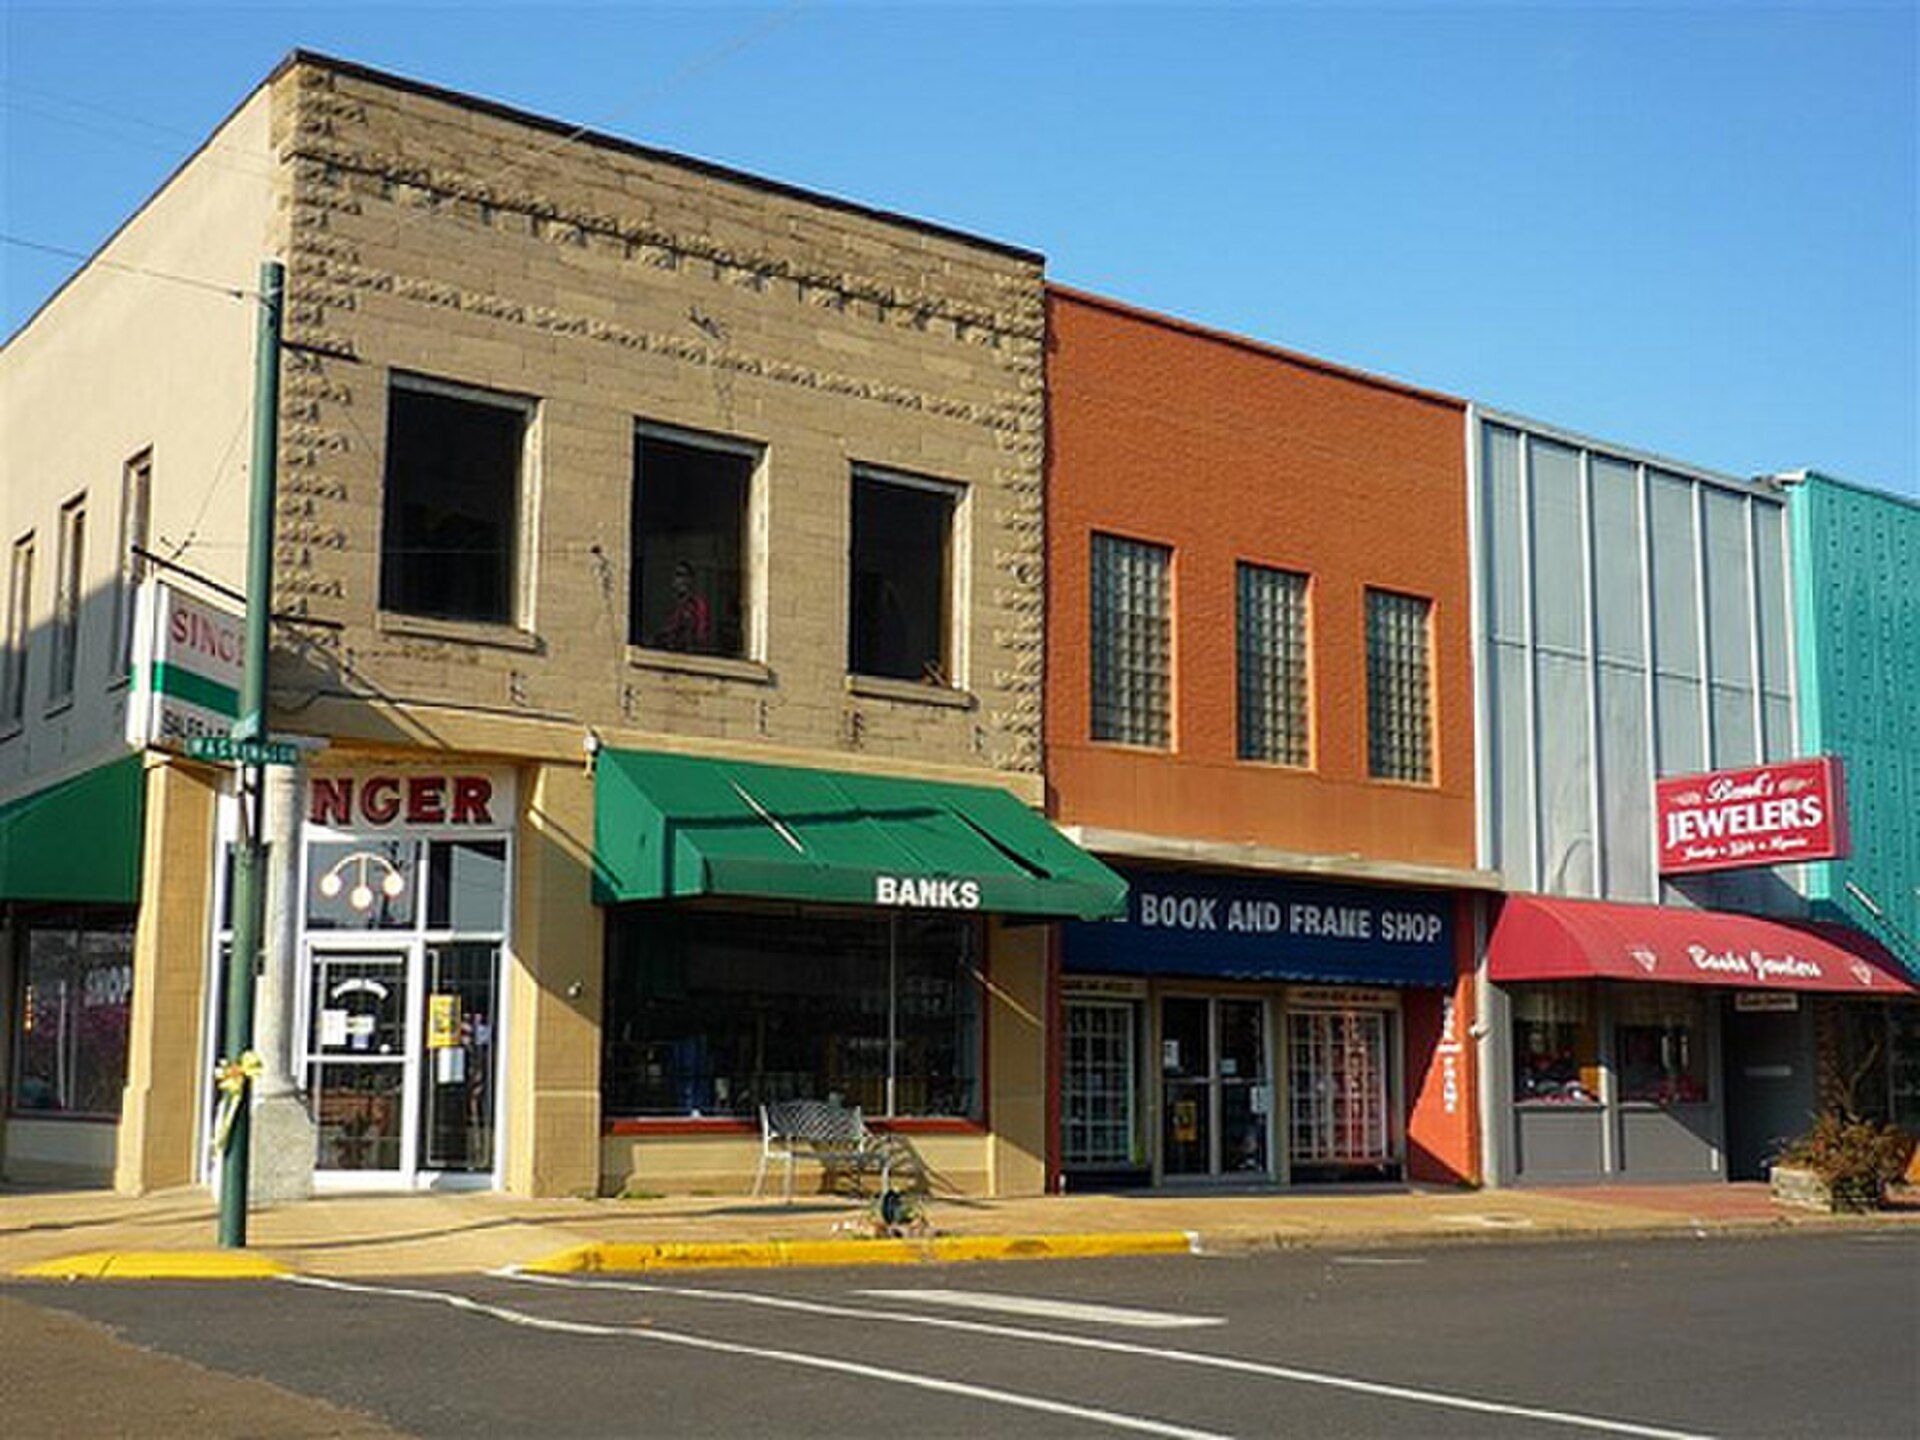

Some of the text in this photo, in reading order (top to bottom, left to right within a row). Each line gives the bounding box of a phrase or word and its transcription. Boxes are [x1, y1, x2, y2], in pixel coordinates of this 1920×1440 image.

[172, 608, 243, 667] SING
[309, 775, 493, 826] NGER
[1666, 796, 1823, 849] JEWELERS
[875, 876, 980, 909] BANKS
[1141, 894, 1442, 942] BOOK AND FRAME SHOP
